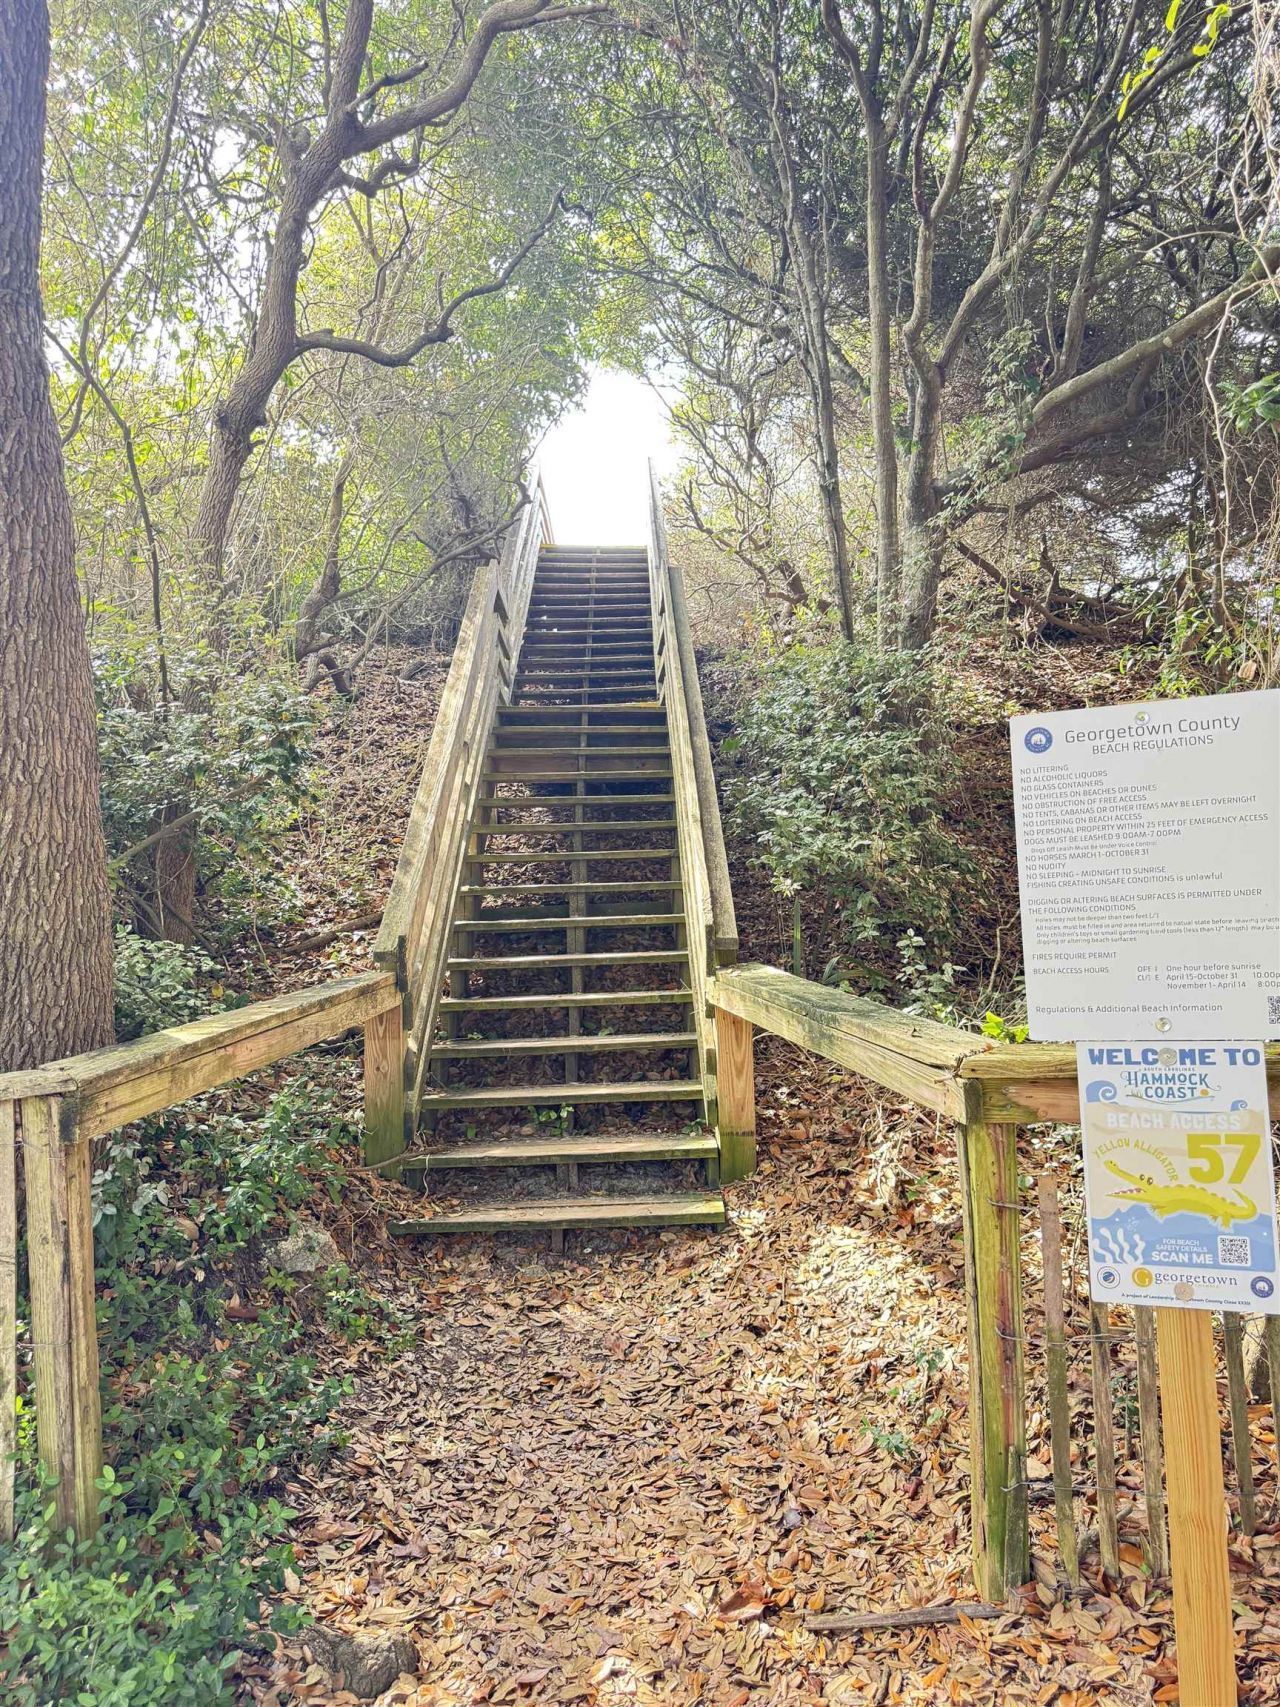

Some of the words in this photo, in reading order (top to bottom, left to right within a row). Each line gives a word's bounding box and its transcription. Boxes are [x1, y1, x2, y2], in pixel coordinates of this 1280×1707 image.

[1065, 723, 1172, 743] Georgetown
[1178, 716, 1240, 732] County
[1092, 743, 1129, 755] BEACH
[1134, 735, 1213, 750] REGULATIONS
[1033, 764, 1068, 774] LITTERING
[1033, 773, 1072, 782] ALCOHOLIC
[1075, 770, 1108, 780] LIQUORS
[1034, 783, 1056, 791] GLASS
[1058, 780, 1104, 790] CONTAINERS
[1034, 791, 1068, 800] VEHICLES
[1083, 788, 1116, 797] BEACHES
[1118, 786, 1128, 794] OR
[1131, 784, 1157, 792] DUNES
[1035, 800, 1086, 809] OBSTRUCTION
[1120, 794, 1146, 803] ACCESS
[1036, 810, 1058, 818] TENTS,
[1060, 807, 1094, 816] CABANAS
[1109, 804, 1134, 812] OTHER
[1136, 802, 1159, 811] ITEMS
[1161, 800, 1178, 809] MAY
[1191, 798, 1209, 806] LEFT
[1210, 796, 1256, 805] OVERNIGHT
[1036, 817, 1074, 826] LOITERING
[1114, 813, 1142, 822] ACCESS
[1036, 826, 1075, 835] PERSONAL
[1077, 824, 1114, 833] PROPERTY
[1116, 822, 1144, 830] WITHIN
[1190, 816, 1237, 826] EMERGENCY
[1240, 814, 1268, 822] ACCESS
[1046, 836, 1068, 844] MUST
[1080, 834, 1113, 842] LEASHED
[1038, 852, 1067, 862] HORSES
[1068, 851, 1096, 860] MARCH
[1039, 862, 1066, 870] NUDITY
[1039, 870, 1074, 880] SLEEPING
[1081, 868, 1120, 878] MIDNIGHT
[1134, 866, 1166, 875] SUNRISE
[1027, 880, 1056, 889] FISHING
[1058, 878, 1094, 888] CREATING
[1096, 878, 1125, 886] UNSAFE
[1128, 874, 1174, 884] CONDITIONS
[1186, 872, 1222, 881] unlawful
[1028, 898, 1059, 906] DIGGING
[1073, 896, 1108, 904] ALTERING
[1136, 892, 1176, 901] SURFACES
[1187, 890, 1232, 898] PERMITTED
[1028, 907, 1042, 915] THE
[1044, 905, 1088, 914] FOLLOWING
[1090, 904, 1136, 913] CONDITIONS
[1086, 914, 1106, 922] deeper
[1054, 952, 1087, 960] REQUIRE
[1166, 973, 1184, 982] April
[1167, 982, 1207, 990] November
[1218, 981, 1236, 990] April
[1036, 1006, 1086, 1014] Regulations
[1096, 1004, 1140, 1012] Additional
[1142, 1004, 1168, 1012] Beach
[1170, 1003, 1222, 1012] Information
[1088, 1048, 1217, 1066] WELCME
[1224, 1048, 1261, 1066] TO
[1123, 1070, 1211, 1088] HAMMOCK
[1144, 1086, 1197, 1098] COAST
[1106, 1112, 1164, 1128] BEACH
[1170, 1114, 1241, 1130] ACCESS
[1094, 1137, 1130, 1158] YELLOW
[1134, 1138, 1179, 1182] ALLIGATOR
[1186, 1134, 1262, 1184] 57
[1180, 1245, 1207, 1253] DETAILS
[1152, 1252, 1188, 1264] SCAN
[1192, 1253, 1214, 1264] ME
[1154, 1272, 1238, 1286] georgetown
